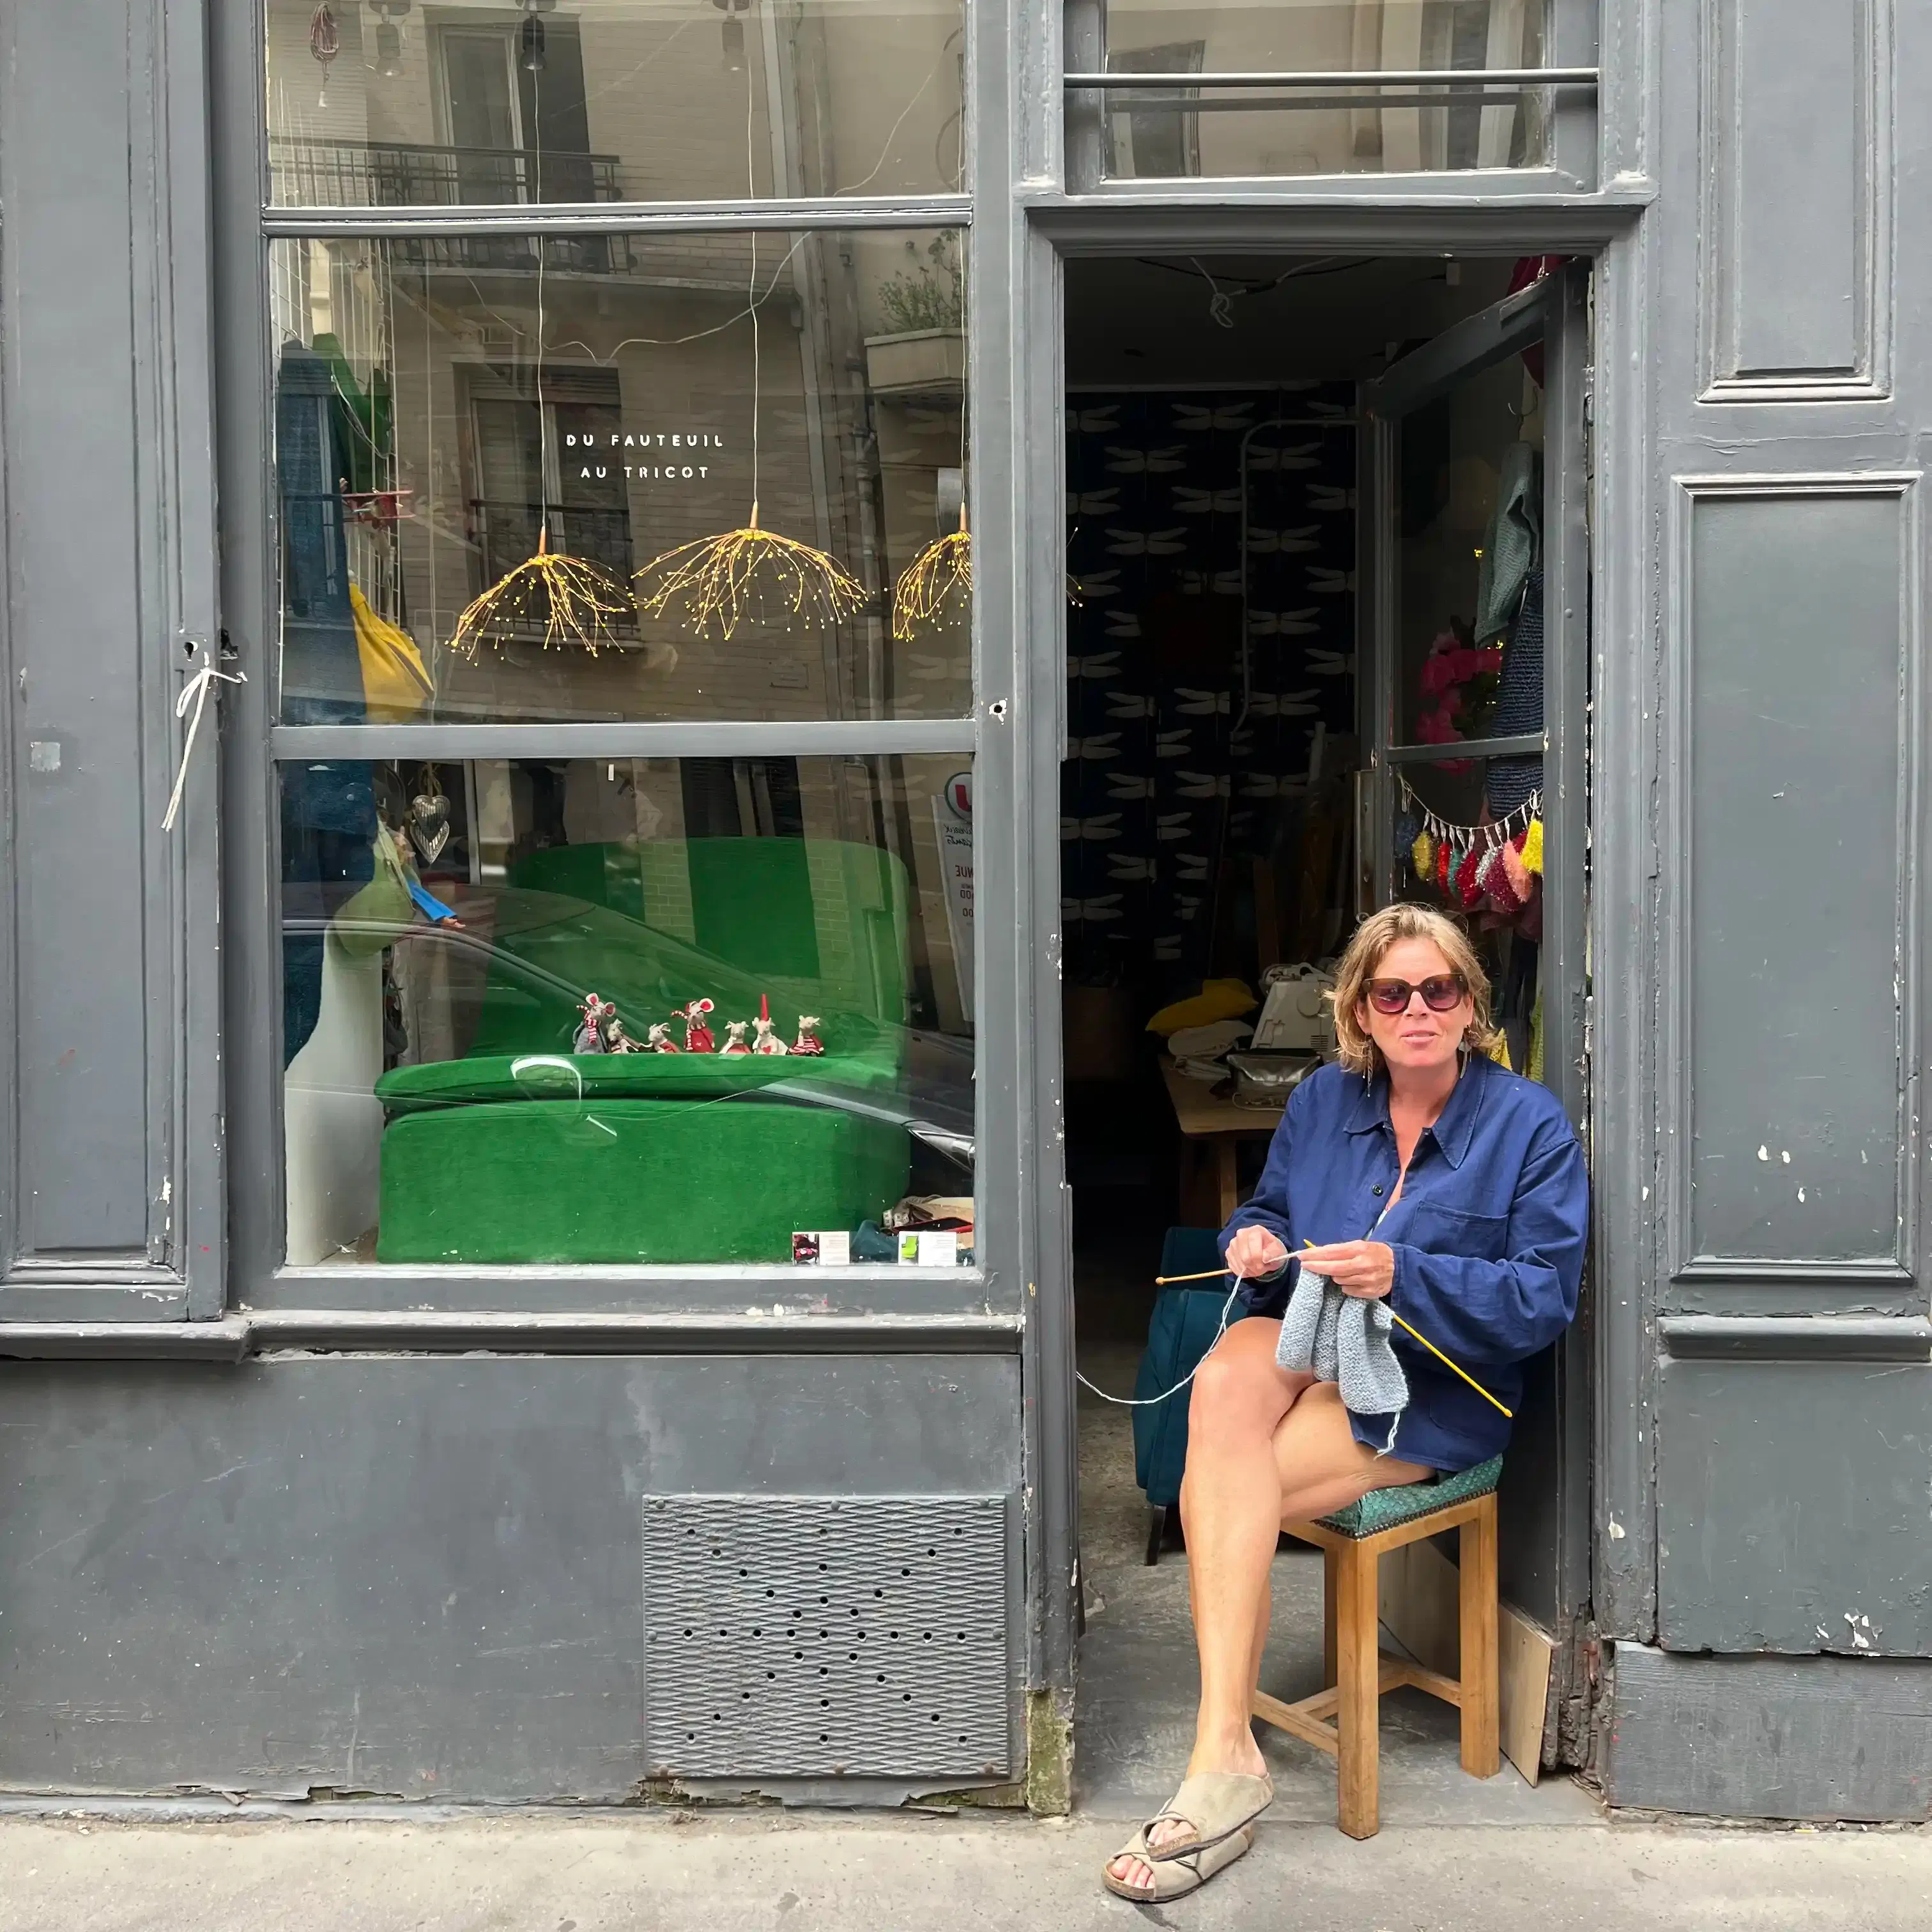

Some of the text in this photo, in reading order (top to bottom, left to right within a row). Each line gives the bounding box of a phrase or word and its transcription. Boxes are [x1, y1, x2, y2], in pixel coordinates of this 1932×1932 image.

[566, 434, 723, 447] DU FAUTEUIL
[580, 466, 708, 479] AU TRICOT
